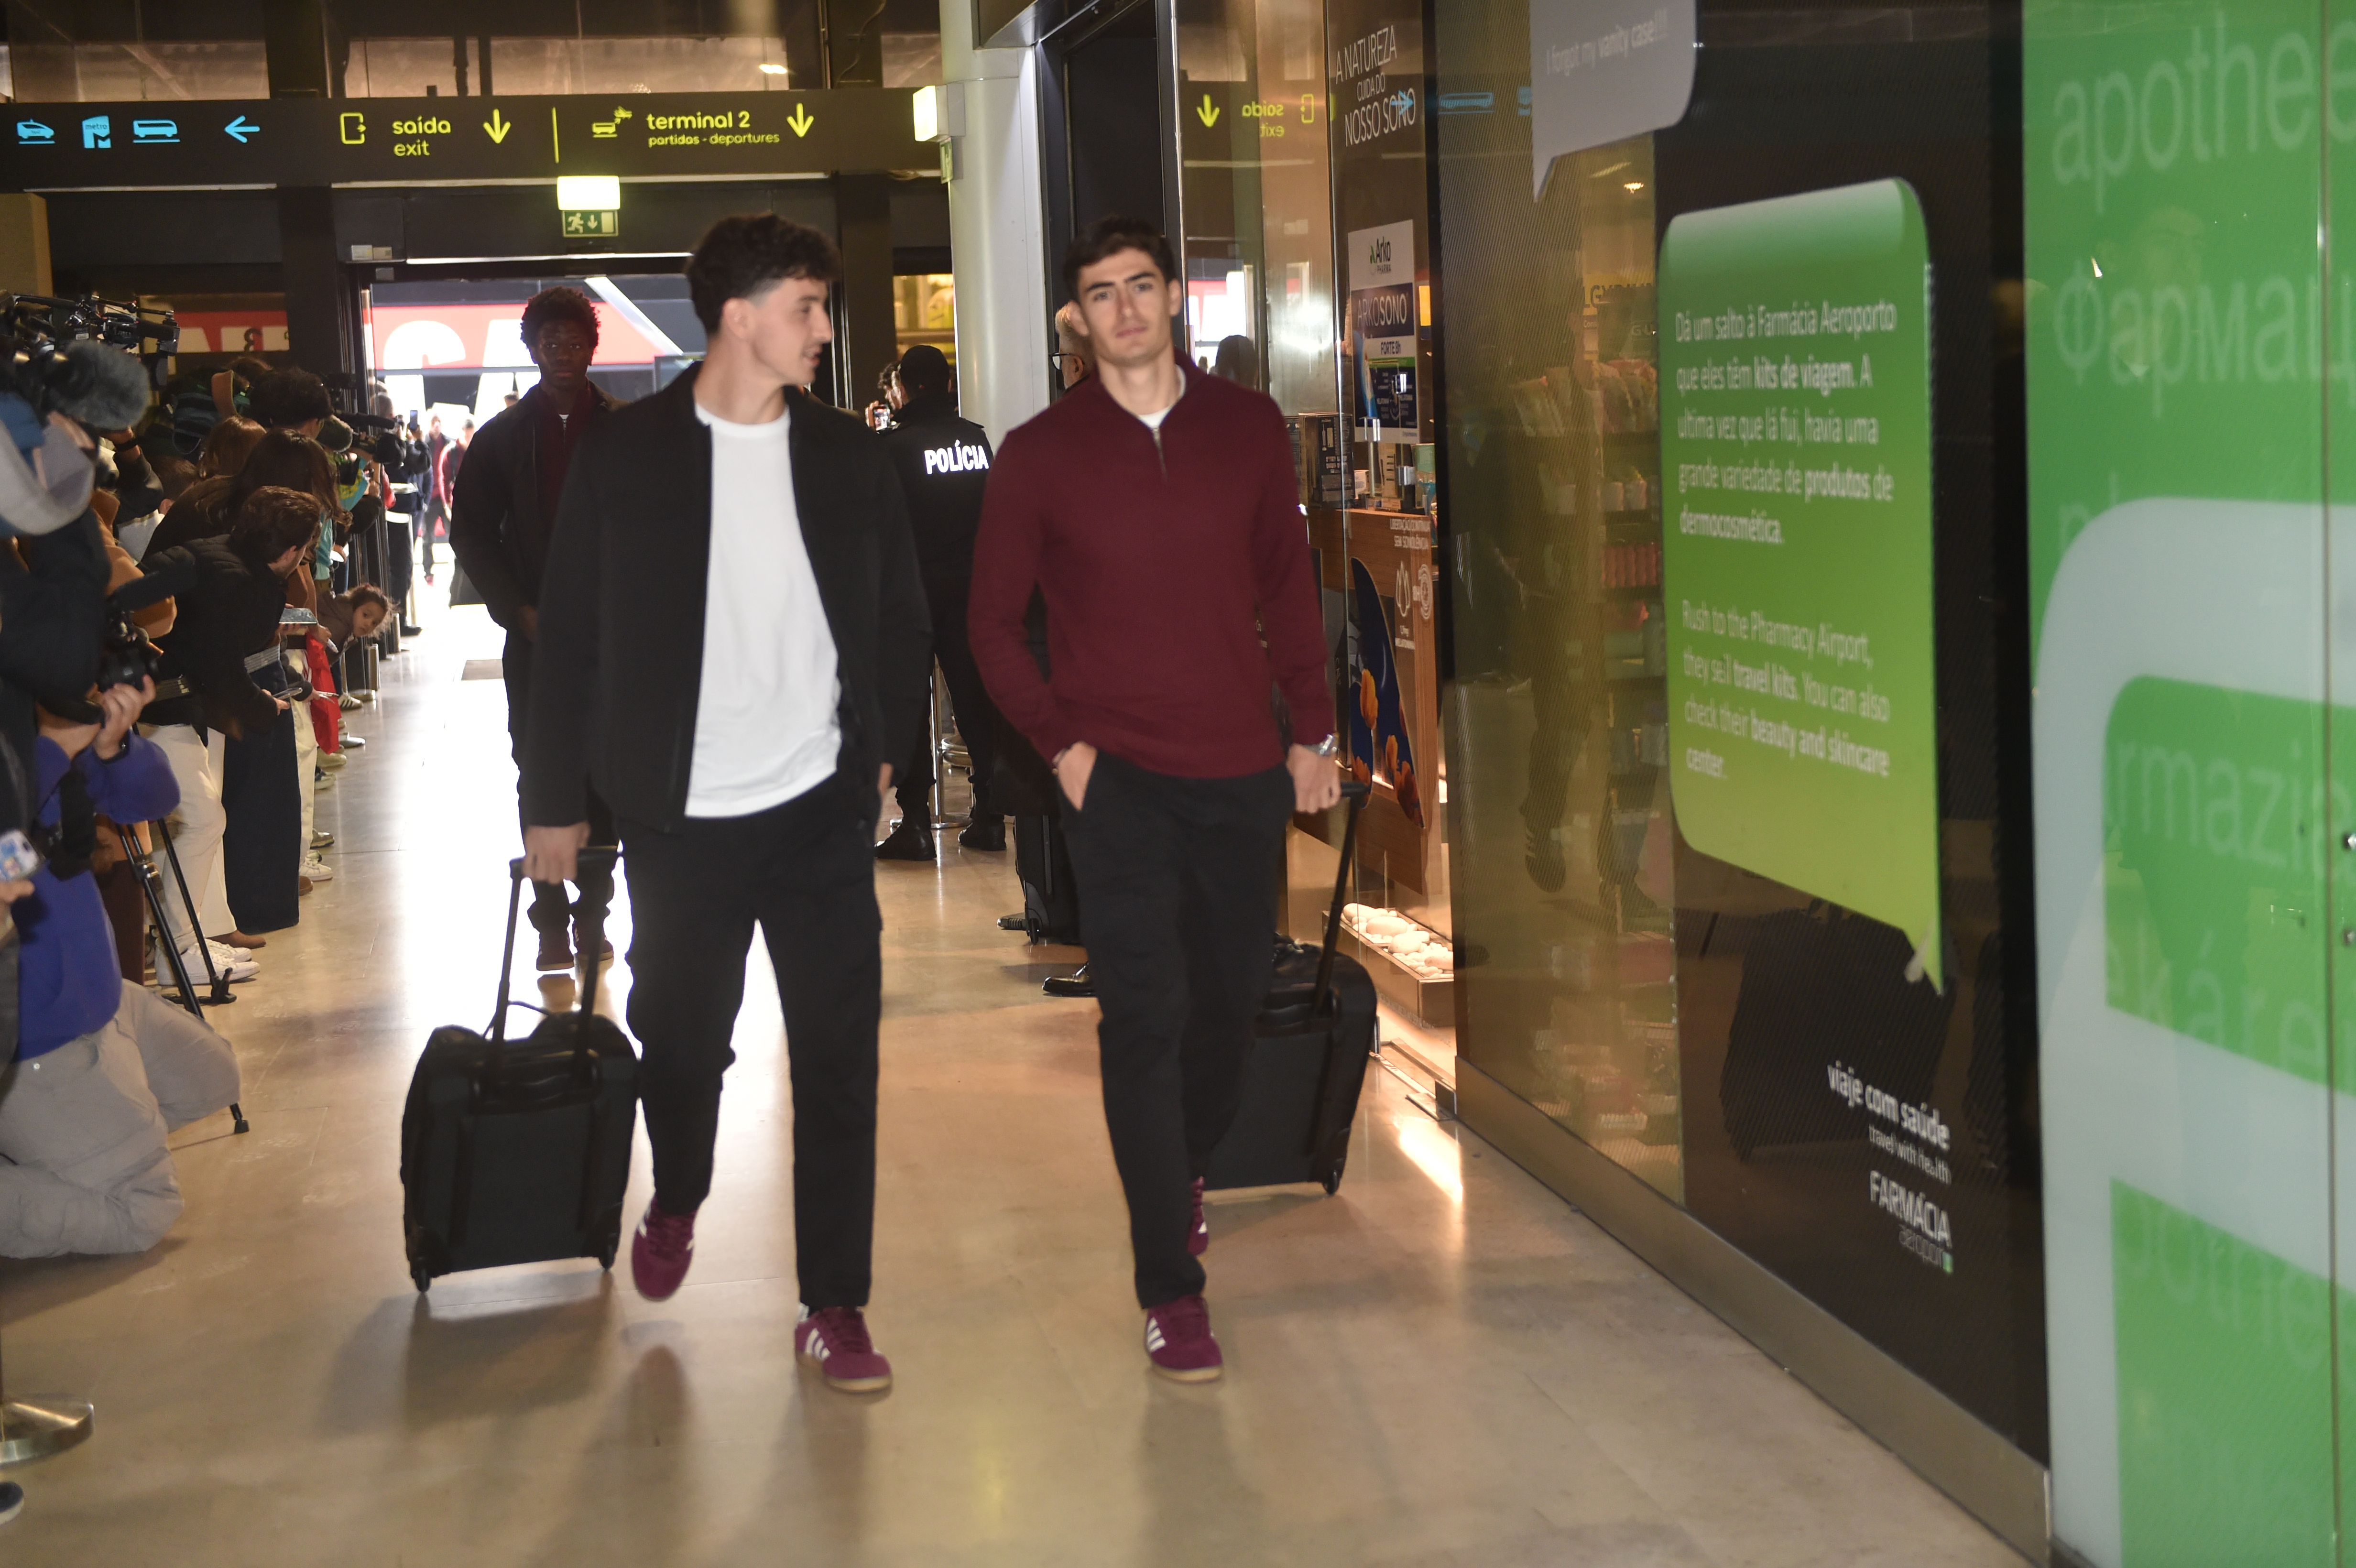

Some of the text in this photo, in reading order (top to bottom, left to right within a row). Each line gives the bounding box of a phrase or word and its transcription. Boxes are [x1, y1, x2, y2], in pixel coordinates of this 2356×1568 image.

[1336, 25, 1397, 85] A NATUREZA
[392, 115, 451, 134] saída
[646, 111, 750, 130] terminal 2
[1345, 87, 1416, 147] NOSSO SONO
[393, 139, 430, 156] exit
[648, 134, 700, 148] partidas
[709, 132, 780, 146] departures
[1376, 236, 1391, 263] Arko
[1357, 293, 1407, 327] ARKOSONO
[1694, 317, 1713, 341] um
[1715, 306, 1745, 340] salto
[1757, 300, 1817, 338] Farmácia
[1820, 298, 1898, 341] Aeroporto
[1381, 341, 1395, 355] FORTE
[1677, 366, 1699, 397] que
[1701, 358, 1725, 390] eles
[1754, 355, 1778, 389] kits
[1780, 354, 1798, 389] de
[1860, 353, 1873, 388] A
[1739, 416, 1764, 447] que
[1804, 406, 1843, 444] havia
[1845, 417, 1879, 445] uma
[924, 439, 989, 474] POLÍCIA
[1679, 456, 1894, 503] grande variedade de produtos de
[1712, 604, 1726, 636] to
[1728, 605, 1749, 640] the
[1750, 610, 1815, 660] Pharmacy
[1684, 645, 1710, 686] they
[1711, 653, 1732, 685] sell
[1733, 659, 1770, 695] travel
[1831, 685, 1858, 714] can
[1859, 684, 1890, 723] also
[1684, 693, 1720, 730] check
[1720, 702, 1749, 737] their
[1750, 708, 1798, 760] beauty
[1799, 725, 1827, 760] and
[1827, 1059, 1951, 1152] viaje com saúde
[1869, 1123, 1952, 1186] travel with health
[1870, 1169, 1953, 1249] FARMÁCIA
